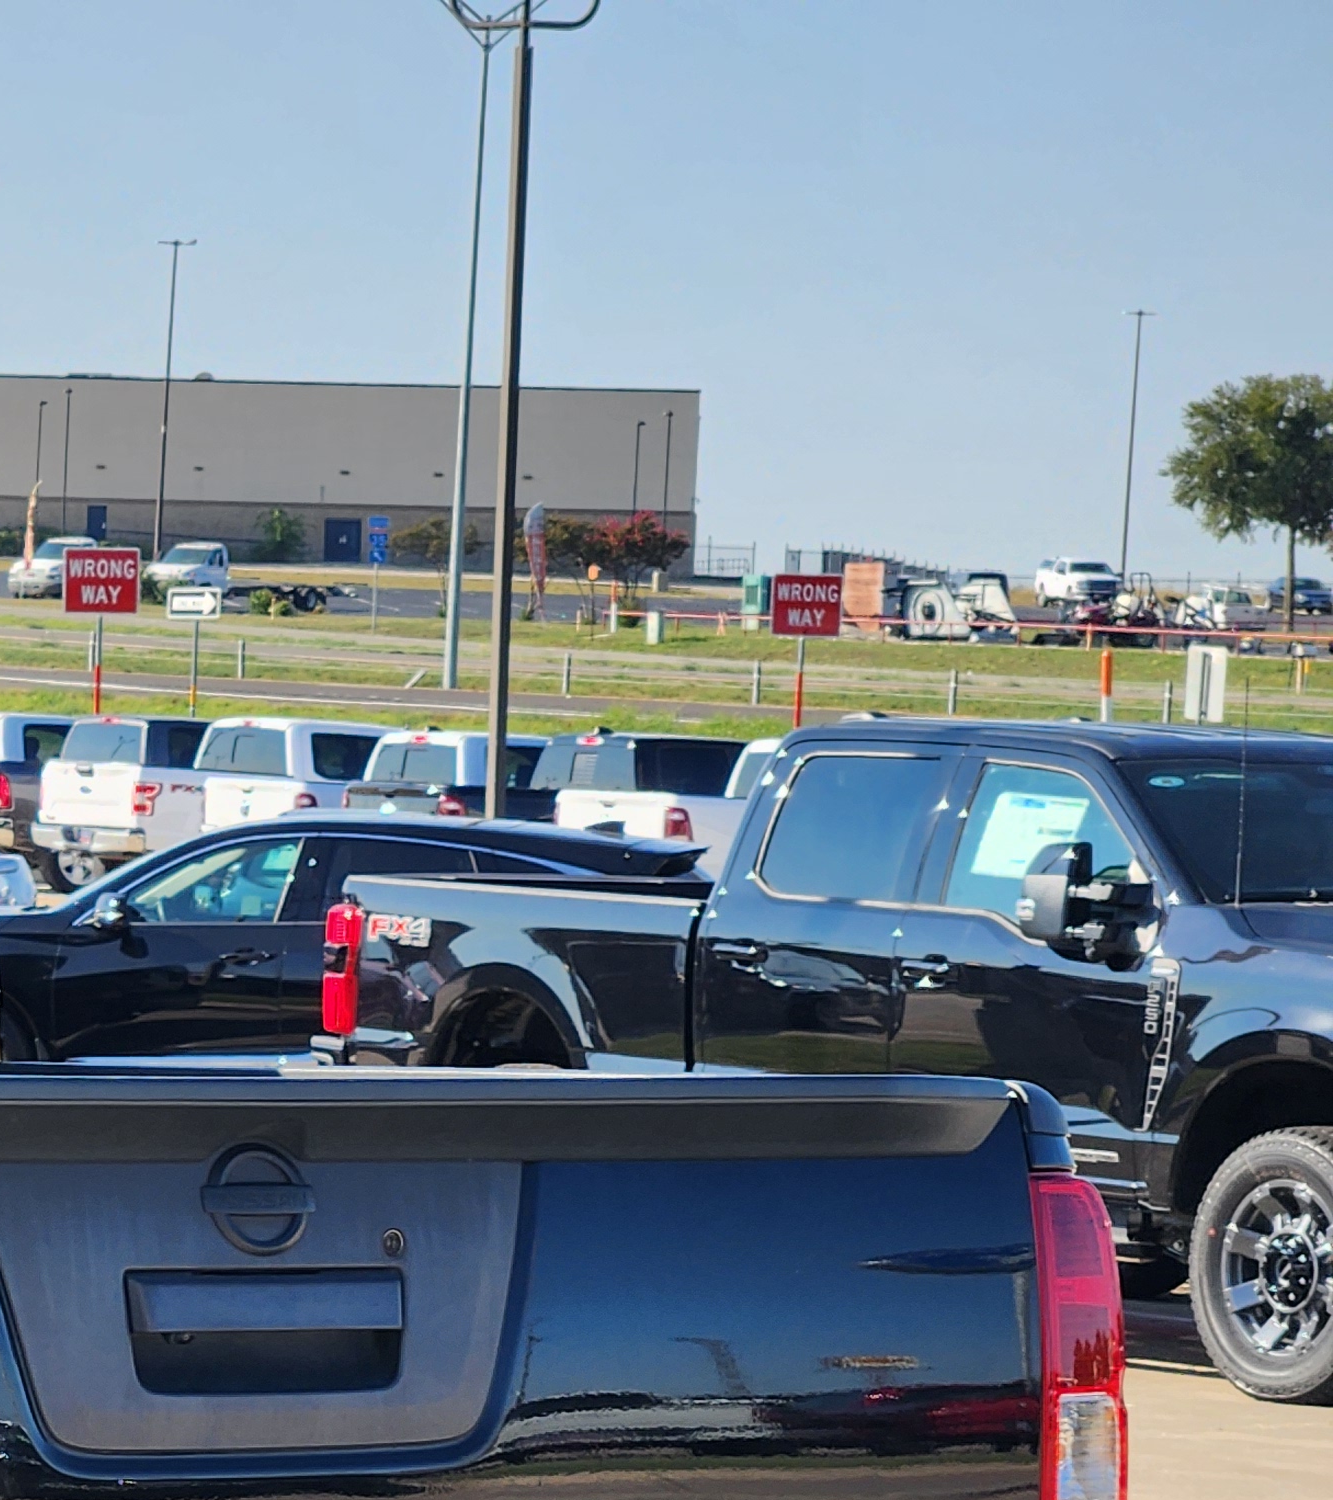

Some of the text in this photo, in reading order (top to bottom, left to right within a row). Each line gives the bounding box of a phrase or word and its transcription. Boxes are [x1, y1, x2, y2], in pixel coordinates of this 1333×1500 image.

[69, 558, 136, 580] WRONG
[81, 585, 122, 605] WAY
[777, 582, 839, 604] WRONG
[787, 608, 826, 628] WAY
[367, 913, 431, 942] FX4
